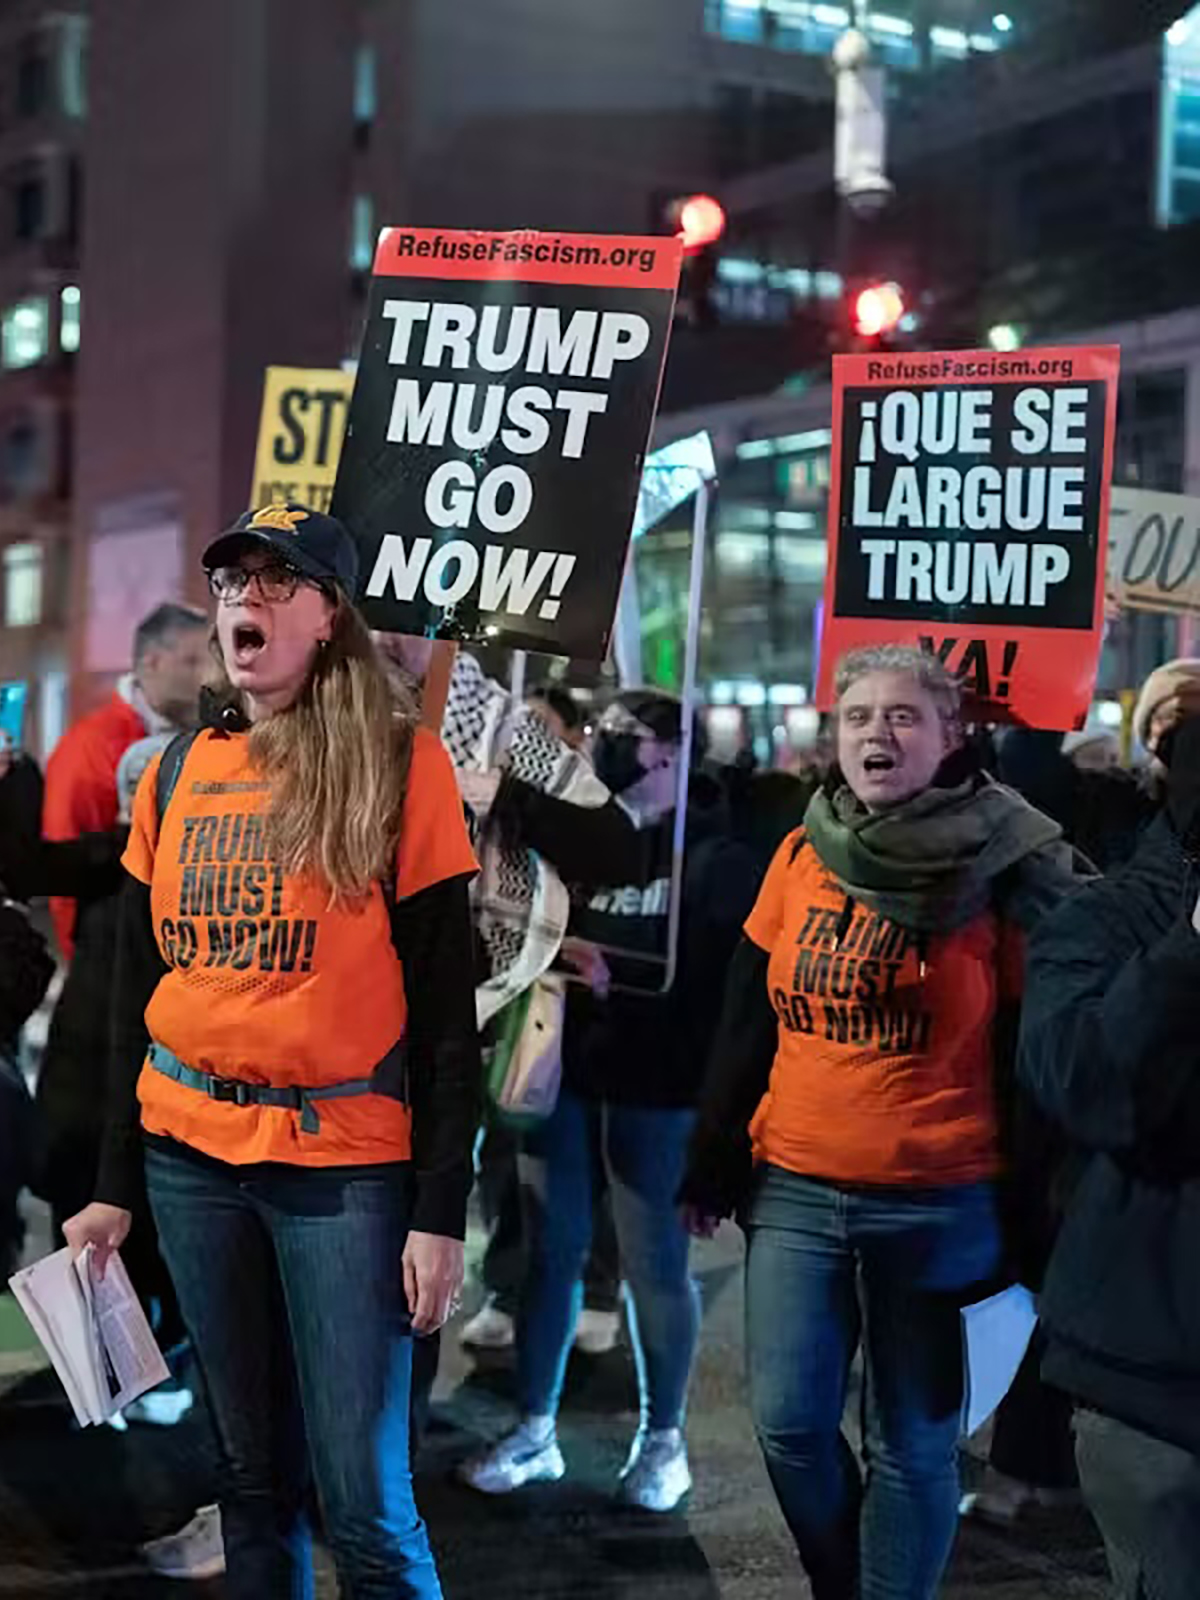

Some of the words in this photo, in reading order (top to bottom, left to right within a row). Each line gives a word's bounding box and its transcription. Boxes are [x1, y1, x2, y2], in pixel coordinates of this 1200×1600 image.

[397, 234, 655, 272] RefuseFascism.org
[382, 299, 650, 379] TRUMP
[867, 358, 1073, 380] RefuseFascism.org
[273, 388, 348, 467] ST
[386, 379, 608, 459] MUST
[858, 390, 993, 462] ¡QUE
[1011, 388, 1088, 454] SE
[424, 460, 533, 533] GO
[852, 464, 1083, 532] LARGUE
[365, 534, 577, 620] NOW!
[861, 539, 1071, 606] TRUMP
[178, 814, 275, 865] TRUM
[179, 864, 284, 917] MUST
[161, 918, 198, 969] GO
[203, 919, 318, 973] NOW!
[793, 948, 904, 1001] MUST
[774, 987, 815, 1034] GO
